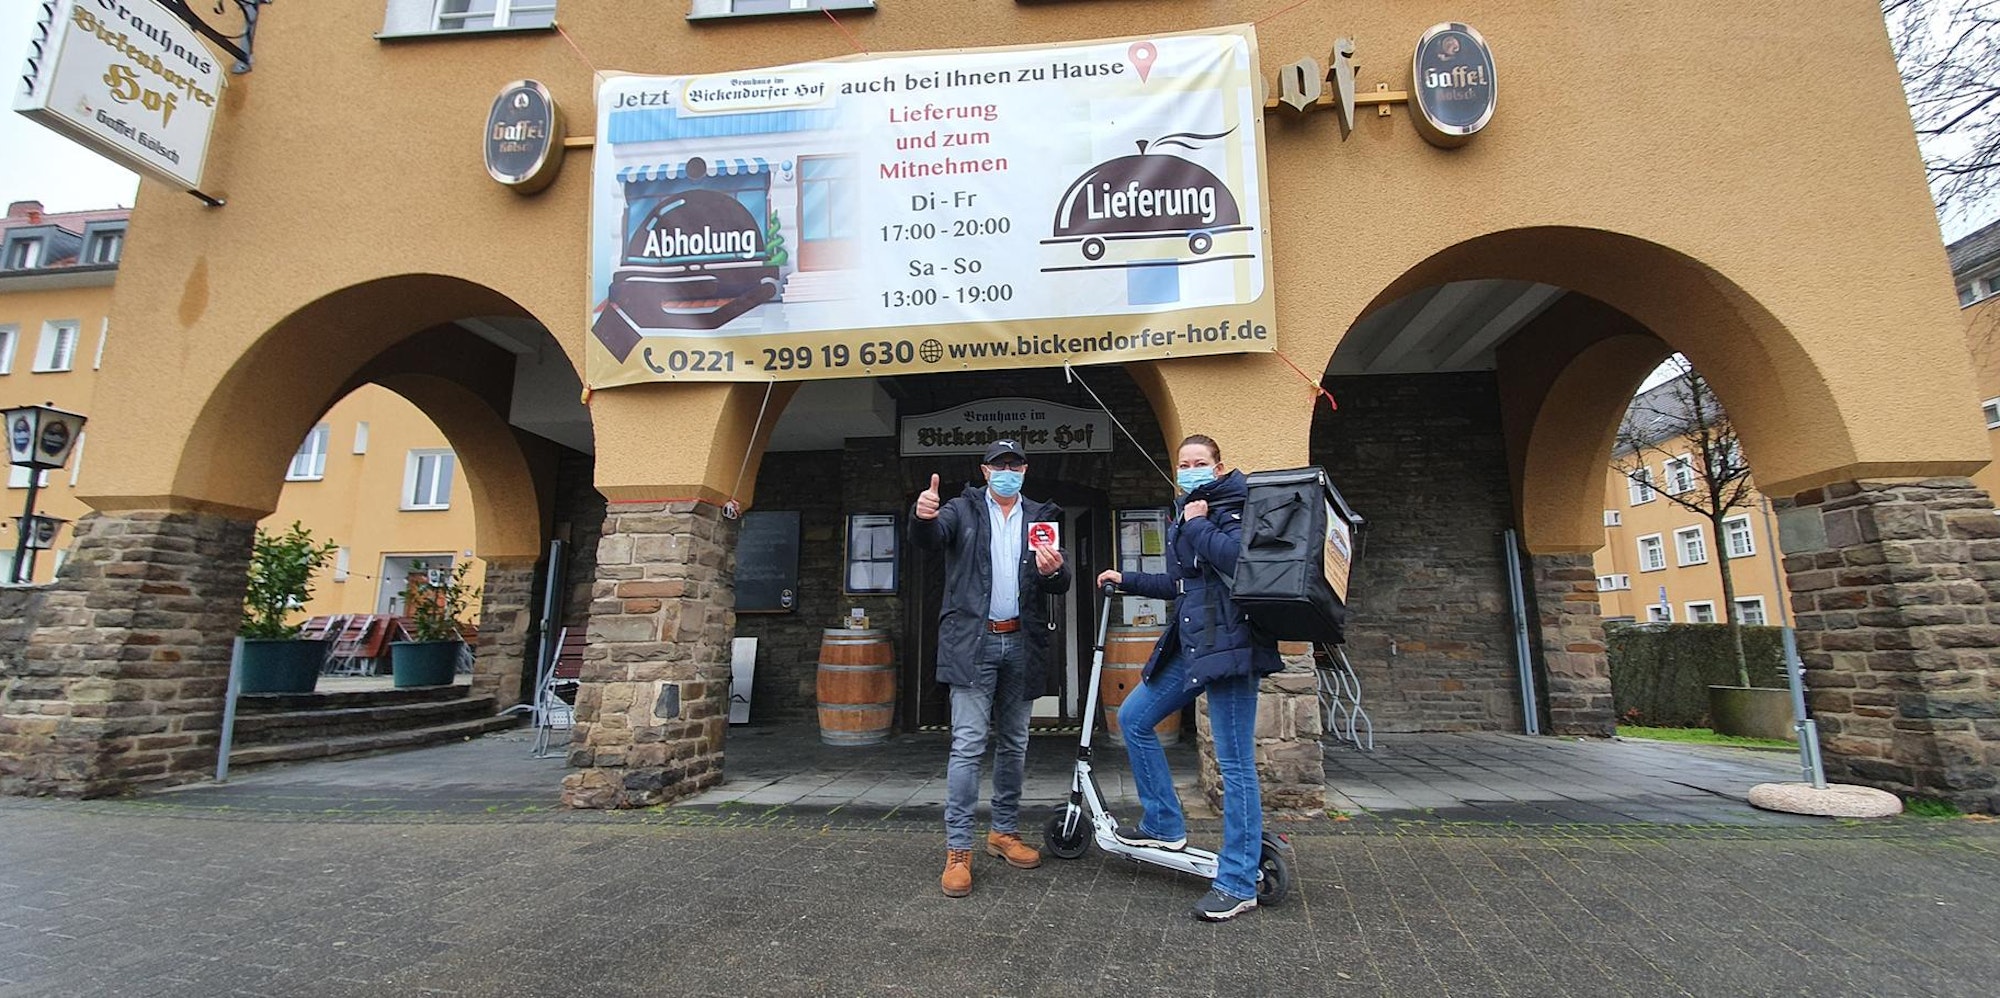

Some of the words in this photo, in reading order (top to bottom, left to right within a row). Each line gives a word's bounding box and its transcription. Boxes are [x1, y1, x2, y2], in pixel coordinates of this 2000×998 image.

[71, 4, 216, 107] Bickendorfer
[774, 77, 784, 85] im
[841, 75, 896, 95] auch
[905, 71, 939, 91] bei
[946, 67, 1011, 88] Ihnen
[1018, 67, 1046, 83] zu
[1052, 59, 1125, 80] Hause
[1261, 36, 1361, 142] of
[1424, 65, 1488, 88] Gaffel
[103, 64, 178, 129] Hof
[613, 89, 670, 109] Jetzt
[689, 87, 789, 102] Bickendorfer
[794, 82, 825, 97] Hof
[96, 108, 137, 142] Gaffel
[889, 102, 998, 124] Lieferung
[493, 120, 545, 141] Gaffel
[896, 131, 936, 151] und
[943, 130, 990, 148] zum
[879, 156, 1008, 179] Mitnehmen
[911, 192, 935, 212] Di
[954, 191, 978, 208] Fr
[1086, 180, 1217, 222] Lieferung
[643, 226, 756, 258] Abholung
[880, 222, 935, 243] 17:00
[953, 217, 1011, 238] 20:00
[909, 259, 935, 277] Sa
[953, 257, 982, 275] So
[881, 288, 937, 308] 13:00
[956, 283, 1013, 304] 19:00
[948, 320, 1267, 358] www.bickendorfer-hof.de
[668, 350, 735, 372] 0221
[763, 347, 812, 371] 299
[821, 345, 850, 368] 19
[859, 340, 914, 365] 630
[964, 410, 1027, 424] Brauhaus
[1031, 409, 1046, 421] im
[918, 425, 1048, 450] Bickendorfer
[1054, 424, 1094, 449] Hof
